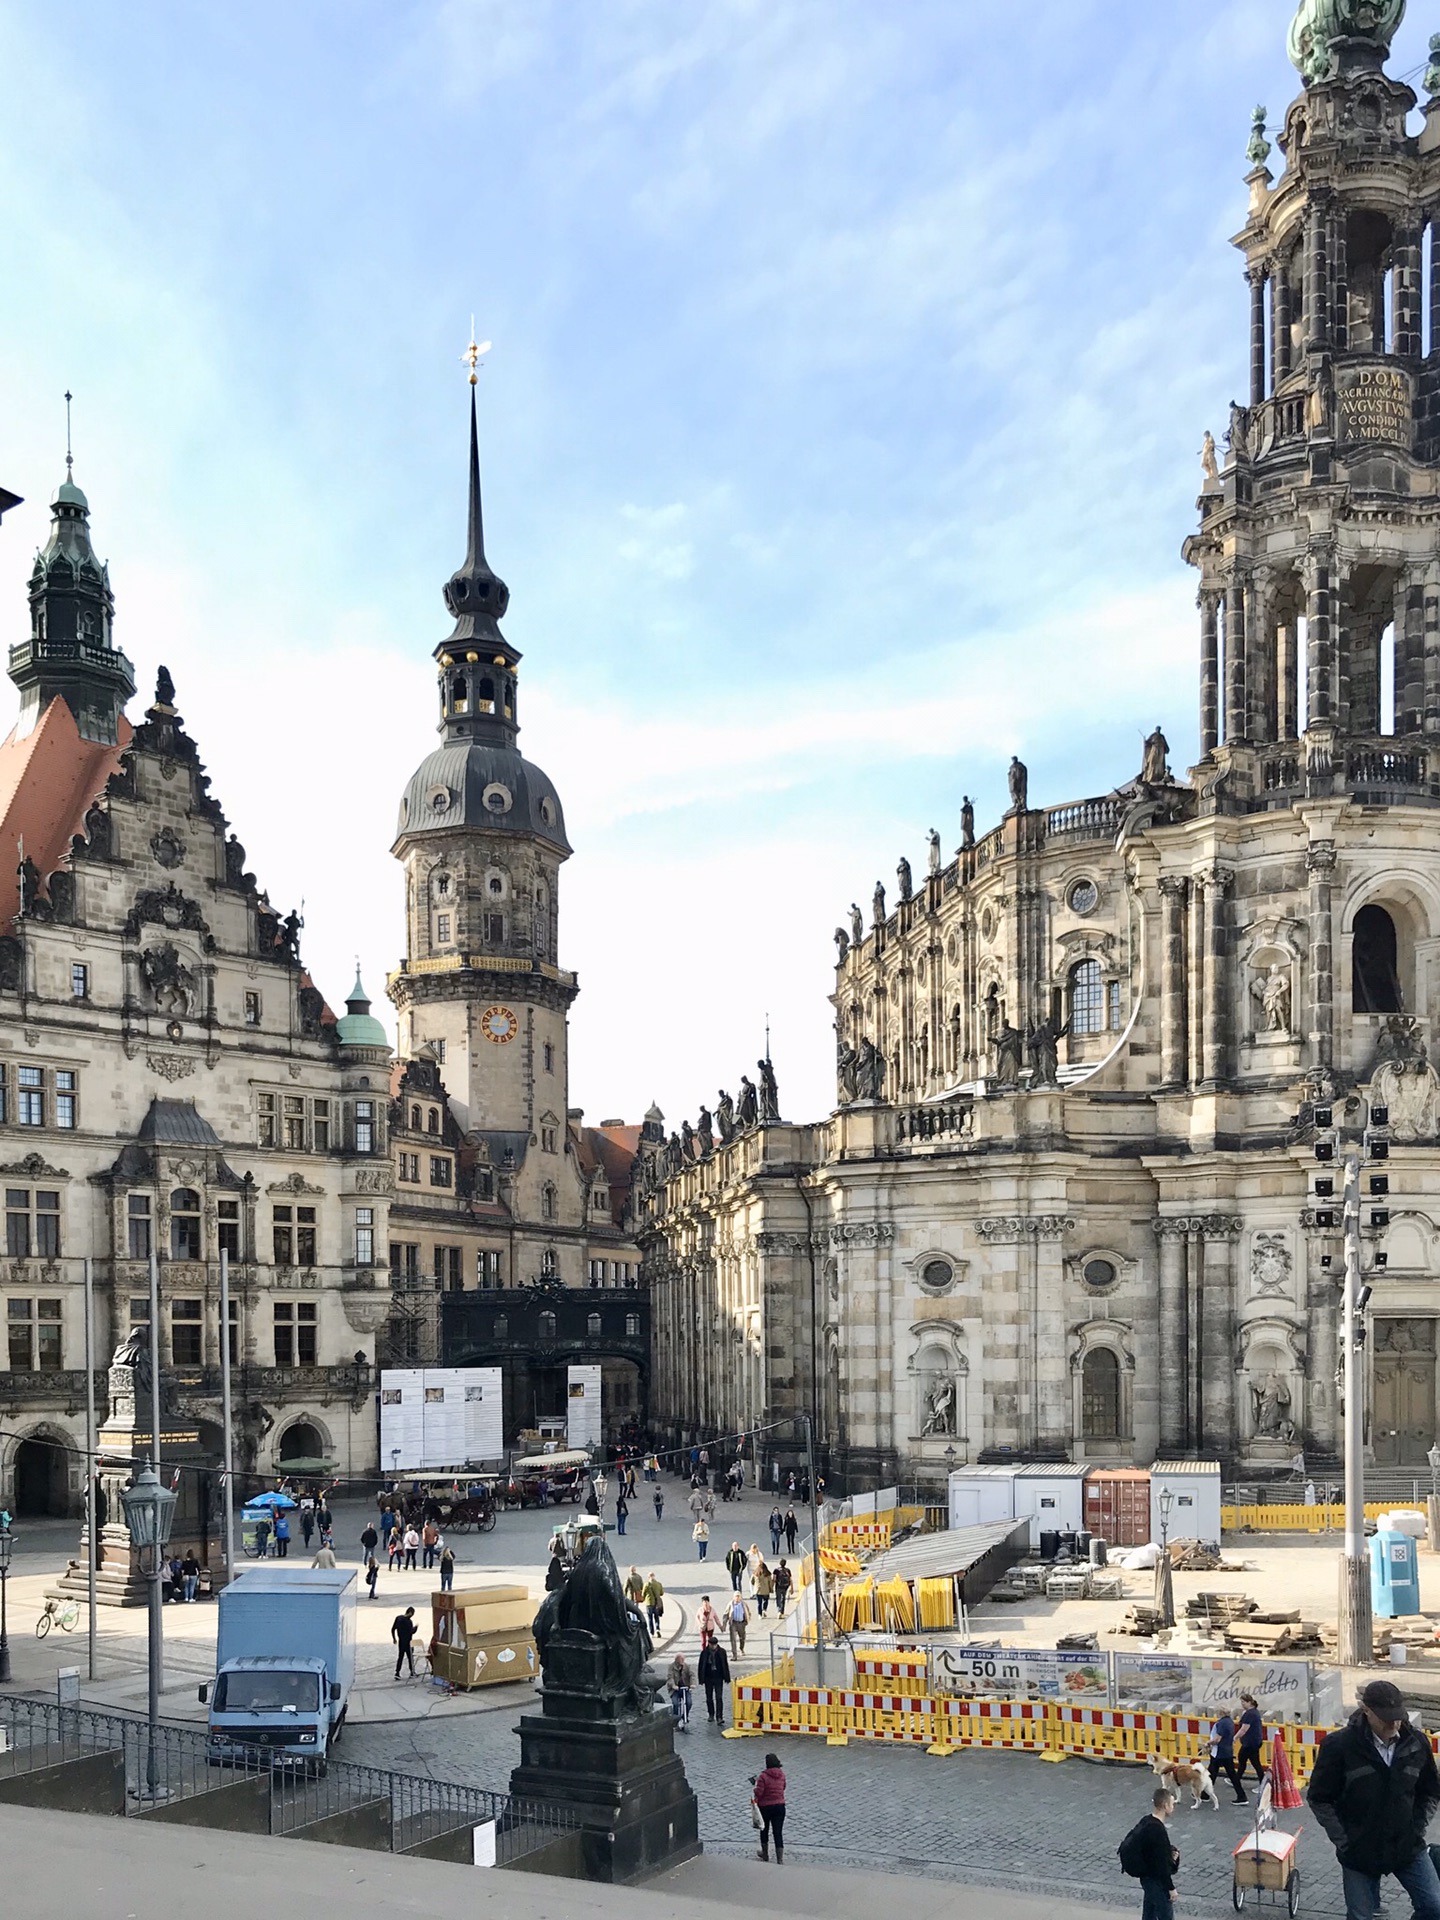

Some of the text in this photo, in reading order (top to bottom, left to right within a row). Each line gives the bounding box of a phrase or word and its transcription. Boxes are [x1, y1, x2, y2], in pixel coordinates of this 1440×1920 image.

[1349, 415, 1403, 428] CONDIDIT
[972, 1661, 1020, 1678] 50 m
